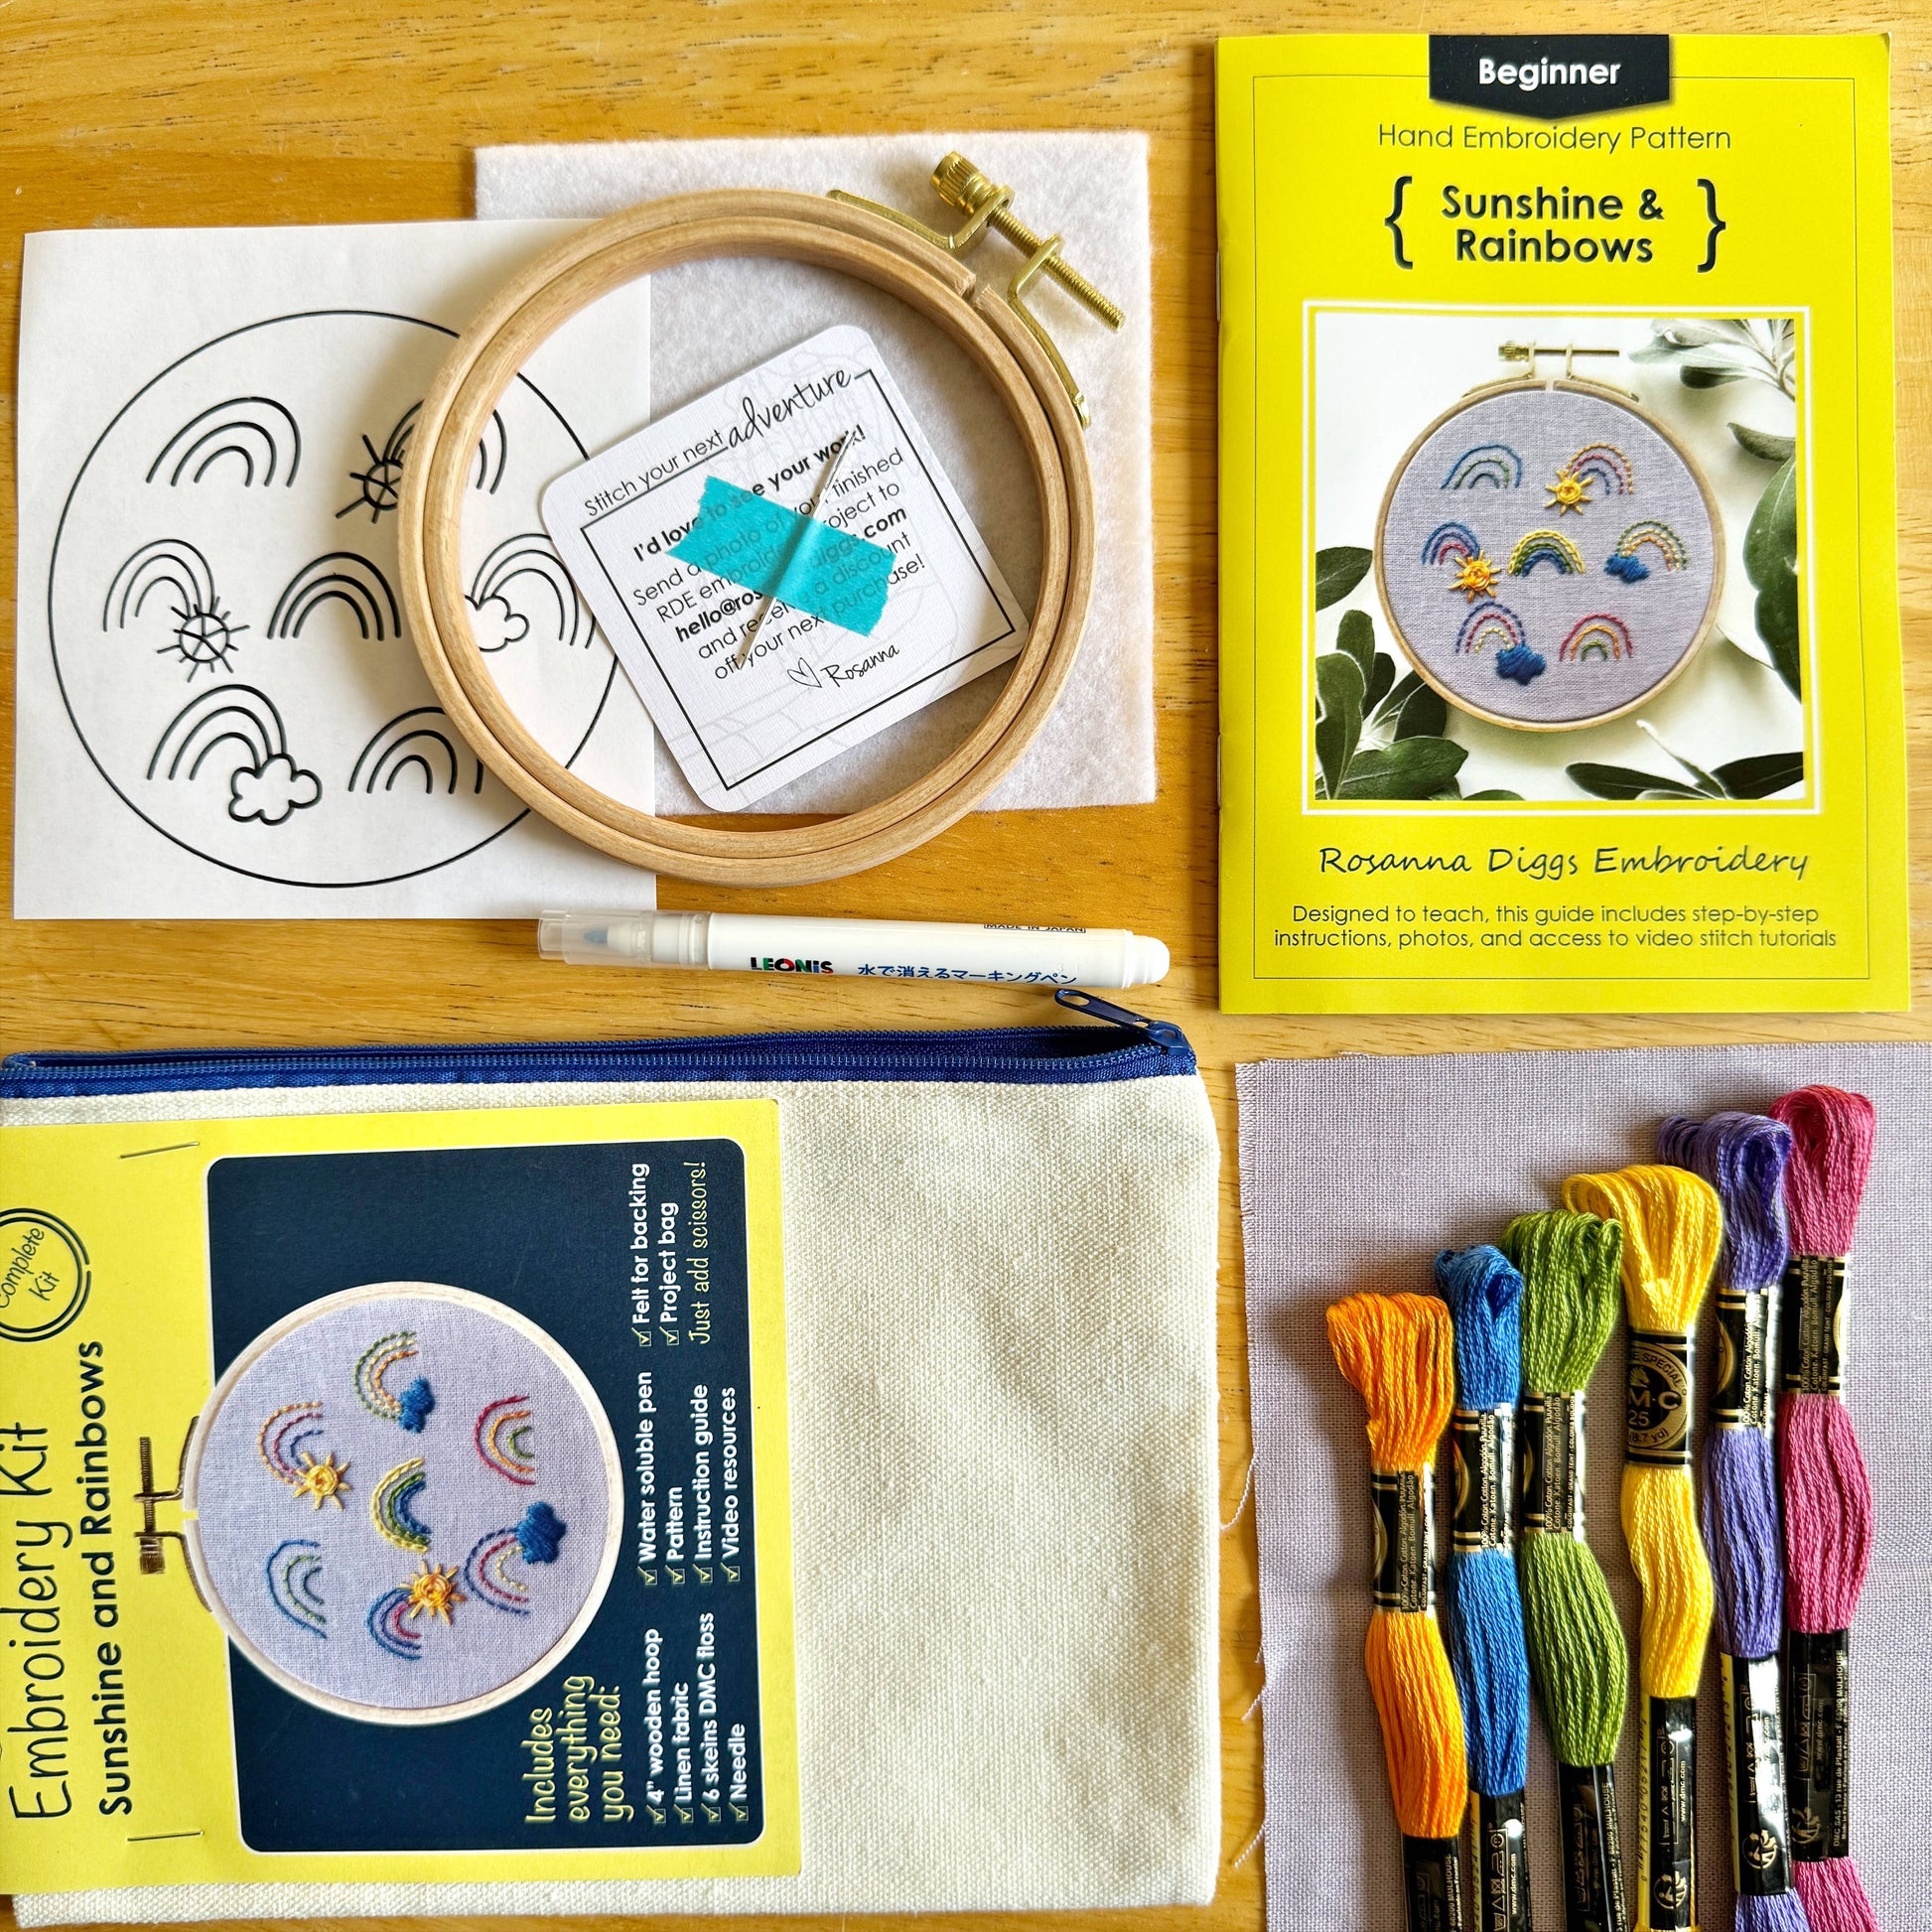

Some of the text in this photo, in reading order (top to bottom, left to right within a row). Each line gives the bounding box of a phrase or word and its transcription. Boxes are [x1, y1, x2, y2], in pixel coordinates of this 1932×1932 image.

[1480, 58, 1620, 90] Beginner
[1380, 124, 1729, 154] Hand Embroidery Pattern
[1443, 186, 1664, 219] Sunshine &
[1457, 229, 1652, 262] Rainbows
[585, 370, 851, 516] Stitch your next adventure
[633, 568, 683, 606] Send
[687, 560, 702, 576] a
[703, 524, 761, 572] photo
[764, 510, 783, 533] of
[656, 483, 899, 622] RDE embroid roject to
[660, 516, 704, 546] love
[705, 502, 728, 521] to
[729, 483, 765, 509] see
[767, 457, 810, 491] your
[699, 627, 738, 658] and
[811, 579, 830, 598] a
[832, 531, 911, 585] discount
[714, 552, 925, 679] off your next purchase!
[820, 645, 899, 687] Rosanna
[1294, 905, 1818, 925] Designed to teach, this guide includes step-by-step
[1320, 846, 1807, 880] Rosanna Diggs Embroidery
[858, 964, 1076, 984] 水で消えるマーキングペン
[1275, 930, 1836, 949] instructions, photos, and access to video stitch tutorials
[29, 1271, 60, 1301] Kit
[628, 1164, 649, 1323] Felt for backing
[658, 1203, 681, 1322] Project bag
[684, 1163, 710, 1343] Just add scissors!
[635, 1372, 656, 1562] Water soluble pen
[666, 1487, 684, 1560] Pattern
[690, 1385, 713, 1559] Instruction guide
[722, 1388, 739, 1559] Video resources
[0, 1423, 72, 1818] Embroidery Kit
[75, 1341, 132, 1815] Sunshine and Rainbows
[642, 1629, 662, 1684] hoop
[697, 1613, 720, 1800] 6 skeins DMC floss
[523, 1708, 558, 1821] Includes
[559, 1676, 600, 1820] everything
[595, 1686, 633, 1820] you need:
[644, 1690, 663, 1775] wooden
[671, 1683, 692, 1801] Linen fabric
[728, 1724, 747, 1799] Needle
